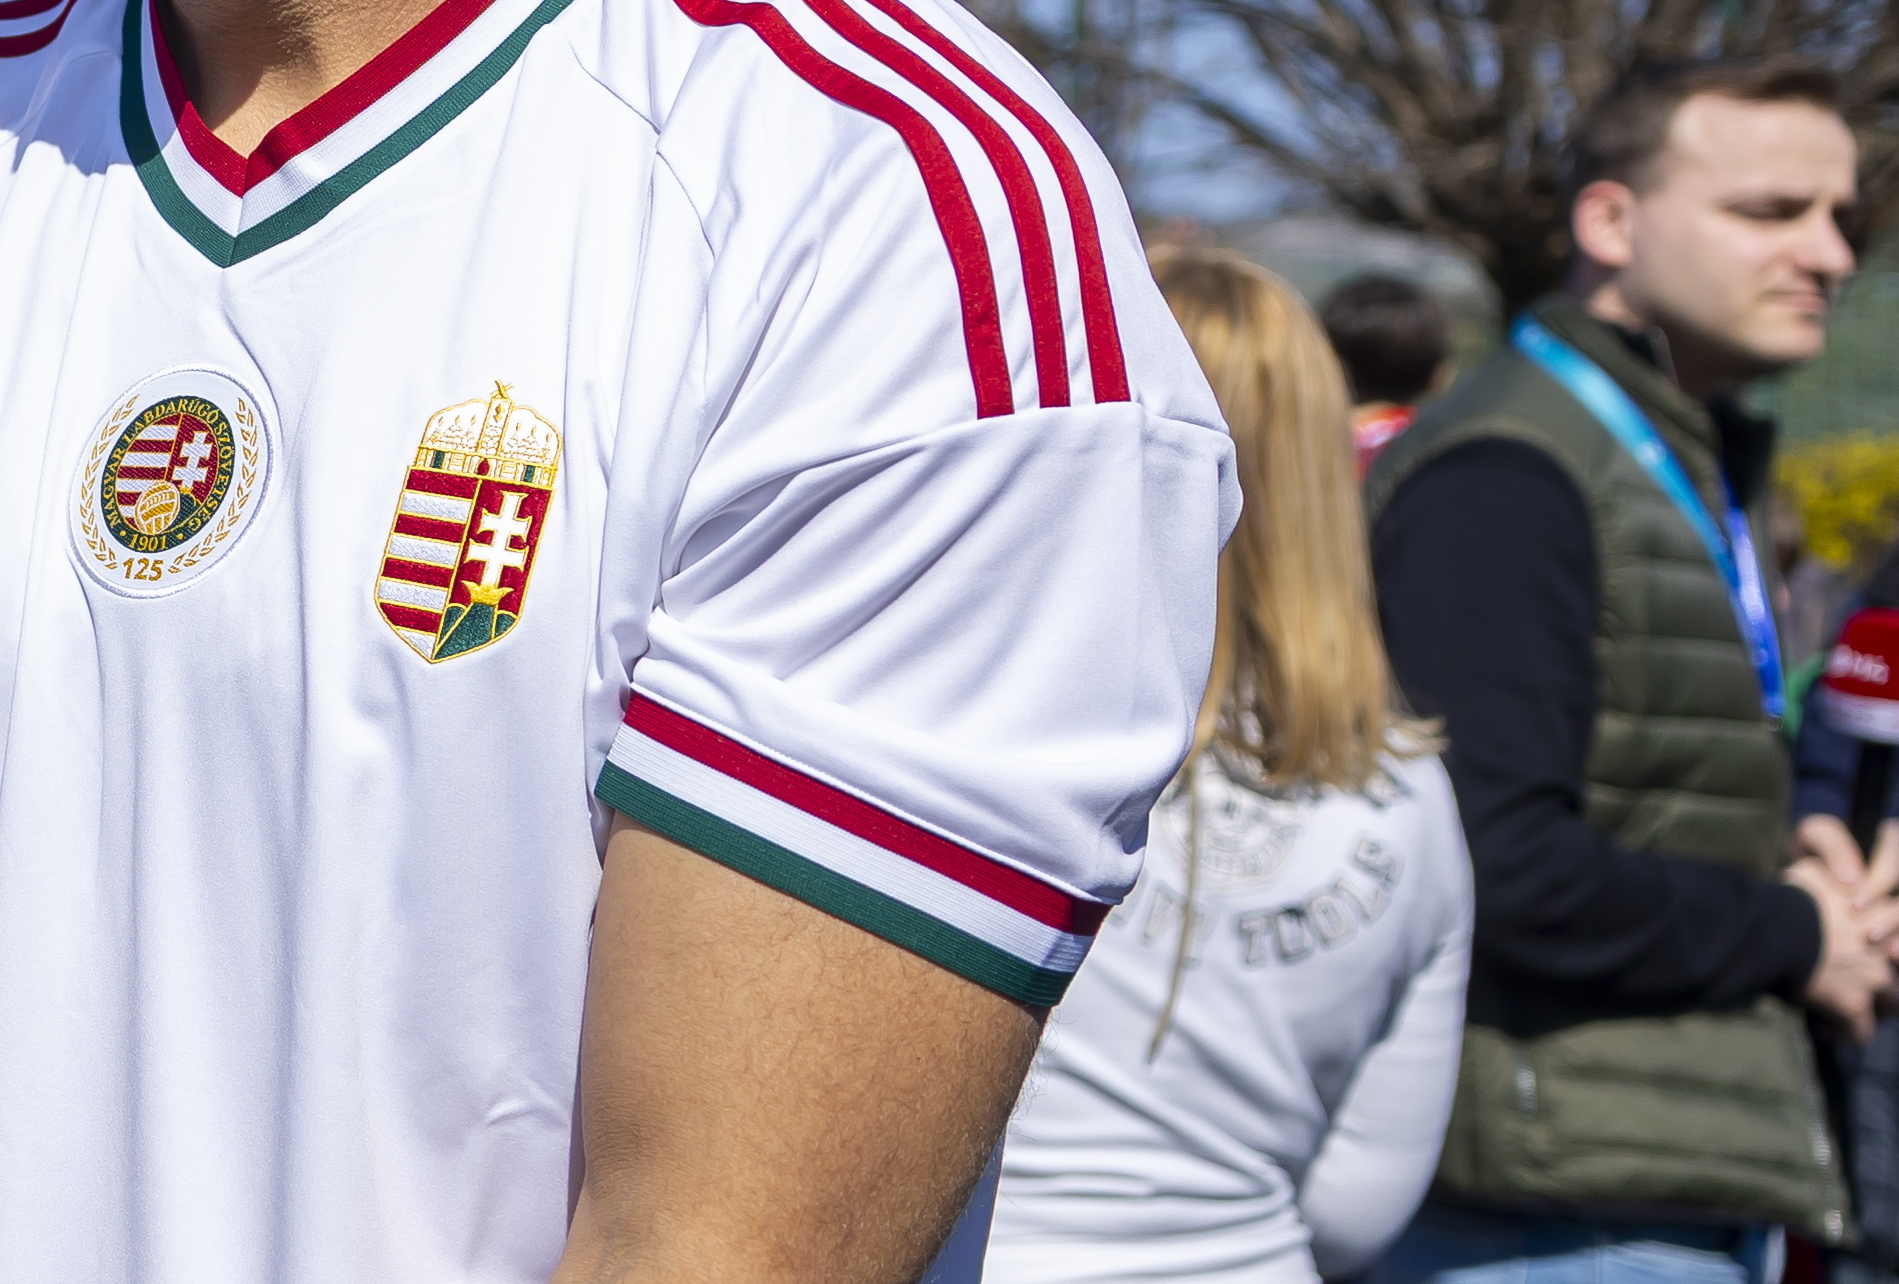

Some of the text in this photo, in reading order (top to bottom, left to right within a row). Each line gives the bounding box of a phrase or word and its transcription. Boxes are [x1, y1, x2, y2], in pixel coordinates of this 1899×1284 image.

[104, 447, 126, 528] MAGYAR
[123, 398, 220, 445] LABDARÚGÓ
[128, 532, 167, 552] 1901
[122, 558, 164, 581] 125
